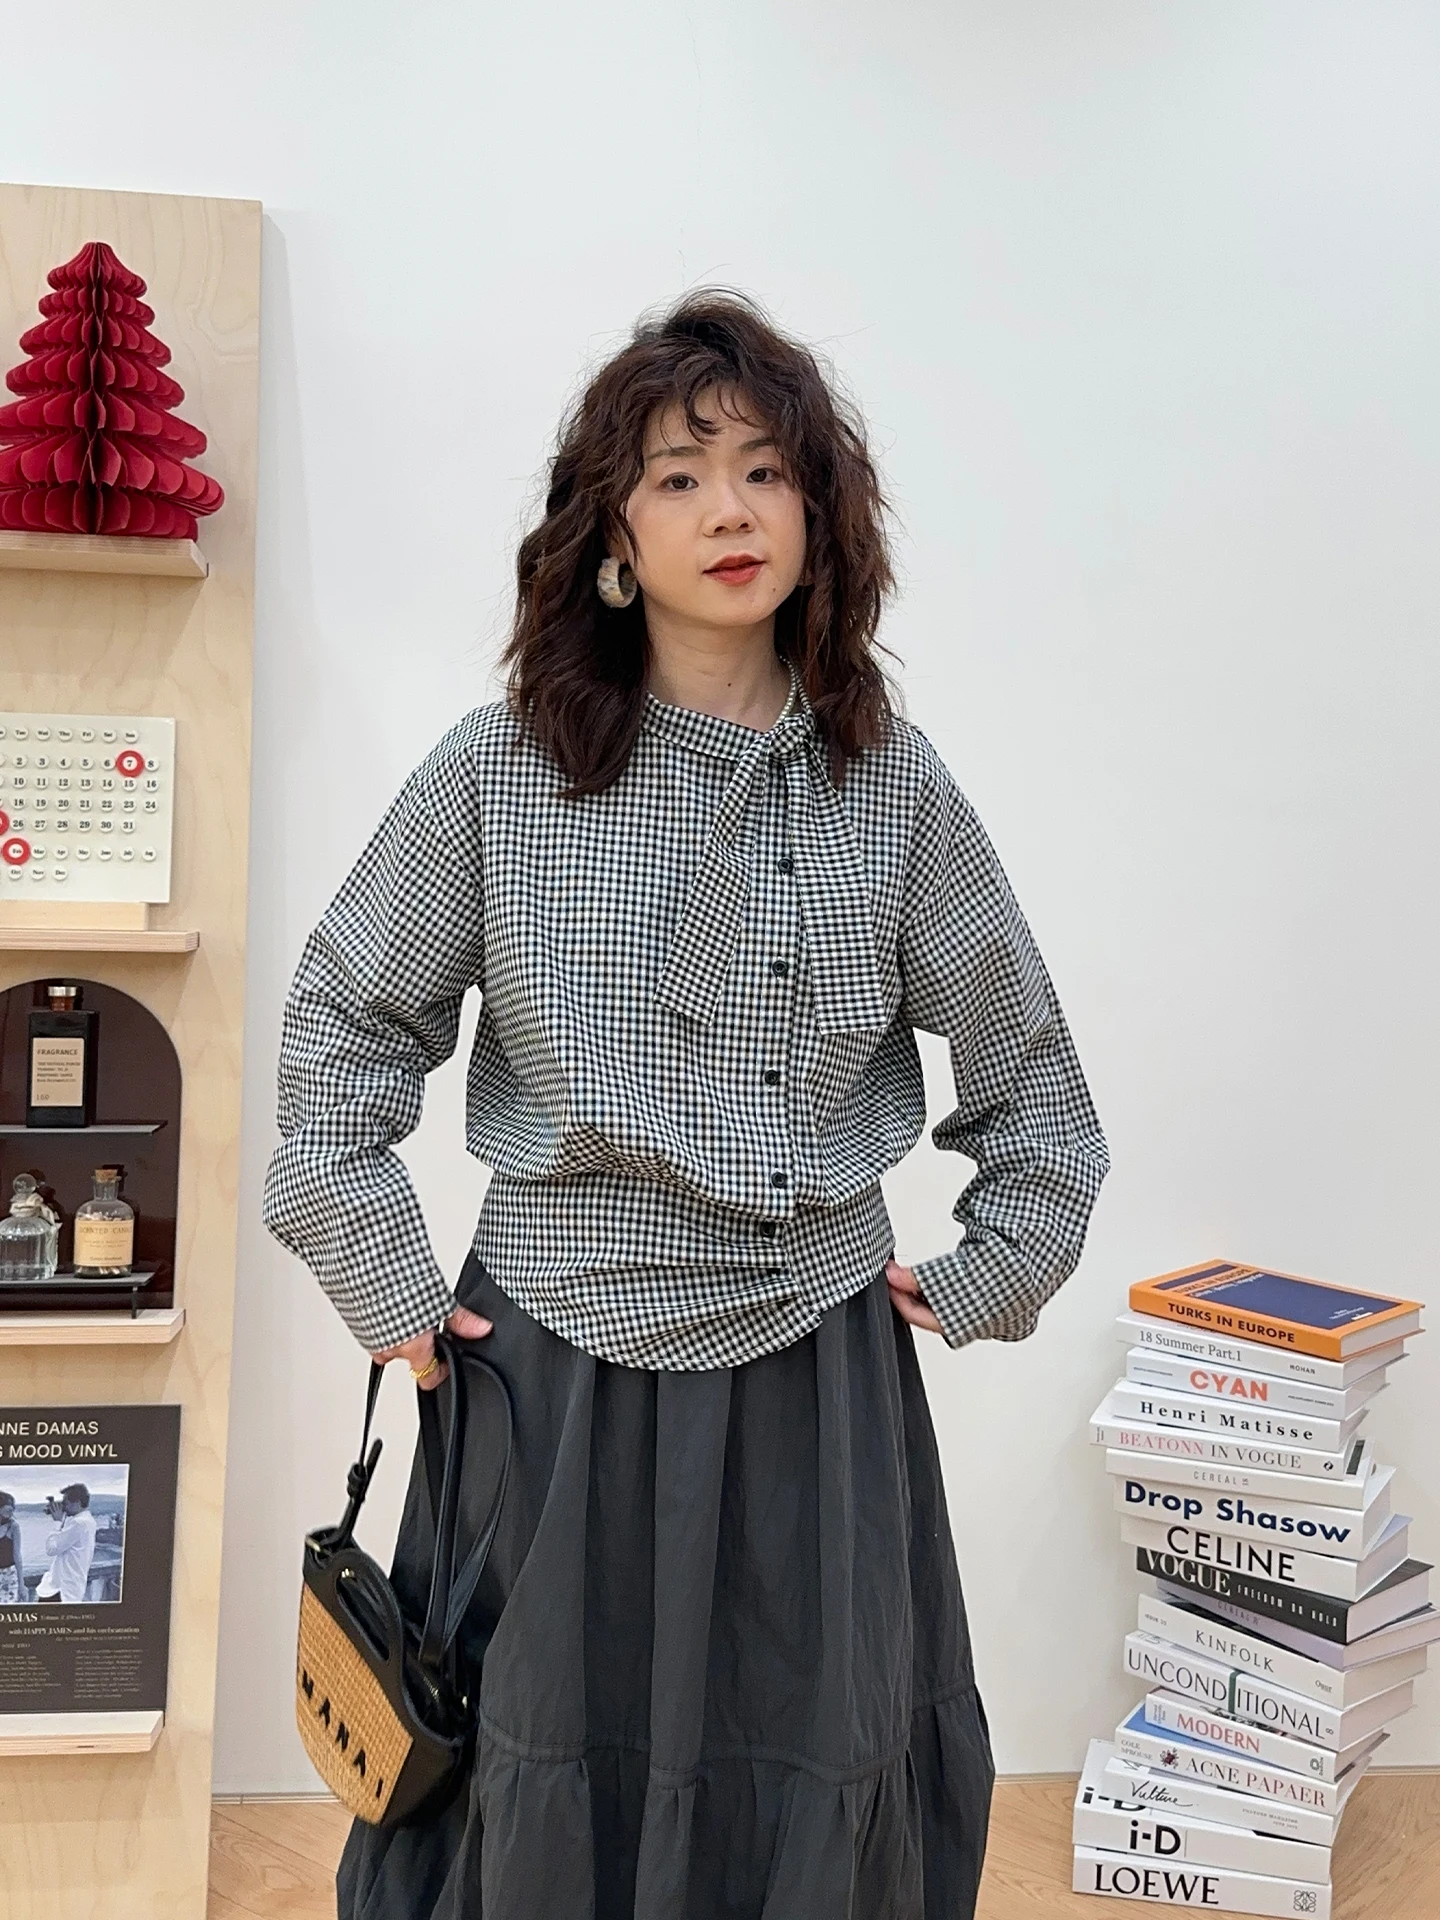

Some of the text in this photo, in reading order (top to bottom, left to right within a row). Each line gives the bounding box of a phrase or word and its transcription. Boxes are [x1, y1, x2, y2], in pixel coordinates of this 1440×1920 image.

[39, 758, 46, 766] 3
[60, 758, 66, 766] 4
[104, 759, 111, 767] 6
[127, 760, 133, 768] 7
[148, 760, 154, 768] 8
[37, 778, 47, 786] 11
[81, 779, 91, 787] 13
[124, 780, 134, 788] 15
[147, 780, 156, 788] 16
[36, 799, 46, 807] 19
[80, 800, 90, 808] 21
[124, 801, 134, 809] 23
[145, 801, 156, 809] 24
[13, 820, 134, 829] 26 27 28 29 30 31
[1168, 1302, 1211, 1322] TURKS
[1217, 1314, 1233, 1327] IN
[1238, 1320, 1295, 1343] EUROPE
[1140, 1330, 1242, 1362] 18 Summer Part.1
[1190, 1370, 1268, 1401] CYAN
[37, 1421, 98, 1435] DAMAS
[1141, 1401, 1313, 1440] Henri Matisse
[9, 1445, 62, 1458] MOOD
[68, 1444, 118, 1458] VINYL
[1119, 1431, 1204, 1456] BEATONN
[1211, 1444, 1230, 1459] IN
[1236, 1448, 1301, 1469] VOGUE
[1193, 1471, 1236, 1485] CEREAL
[1125, 1480, 1351, 1543] Drop Shasow
[1167, 1526, 1295, 1582] CELINE
[1144, 1552, 1231, 1597] VOGUE
[1196, 1630, 1274, 1673] KINFOLK
[1177, 1713, 1260, 1753] MODERN
[1186, 1758, 1326, 1808] ACNE PAPAER
[1130, 1820, 1181, 1855] i-D
[1095, 1864, 1219, 1904] LOEWE
